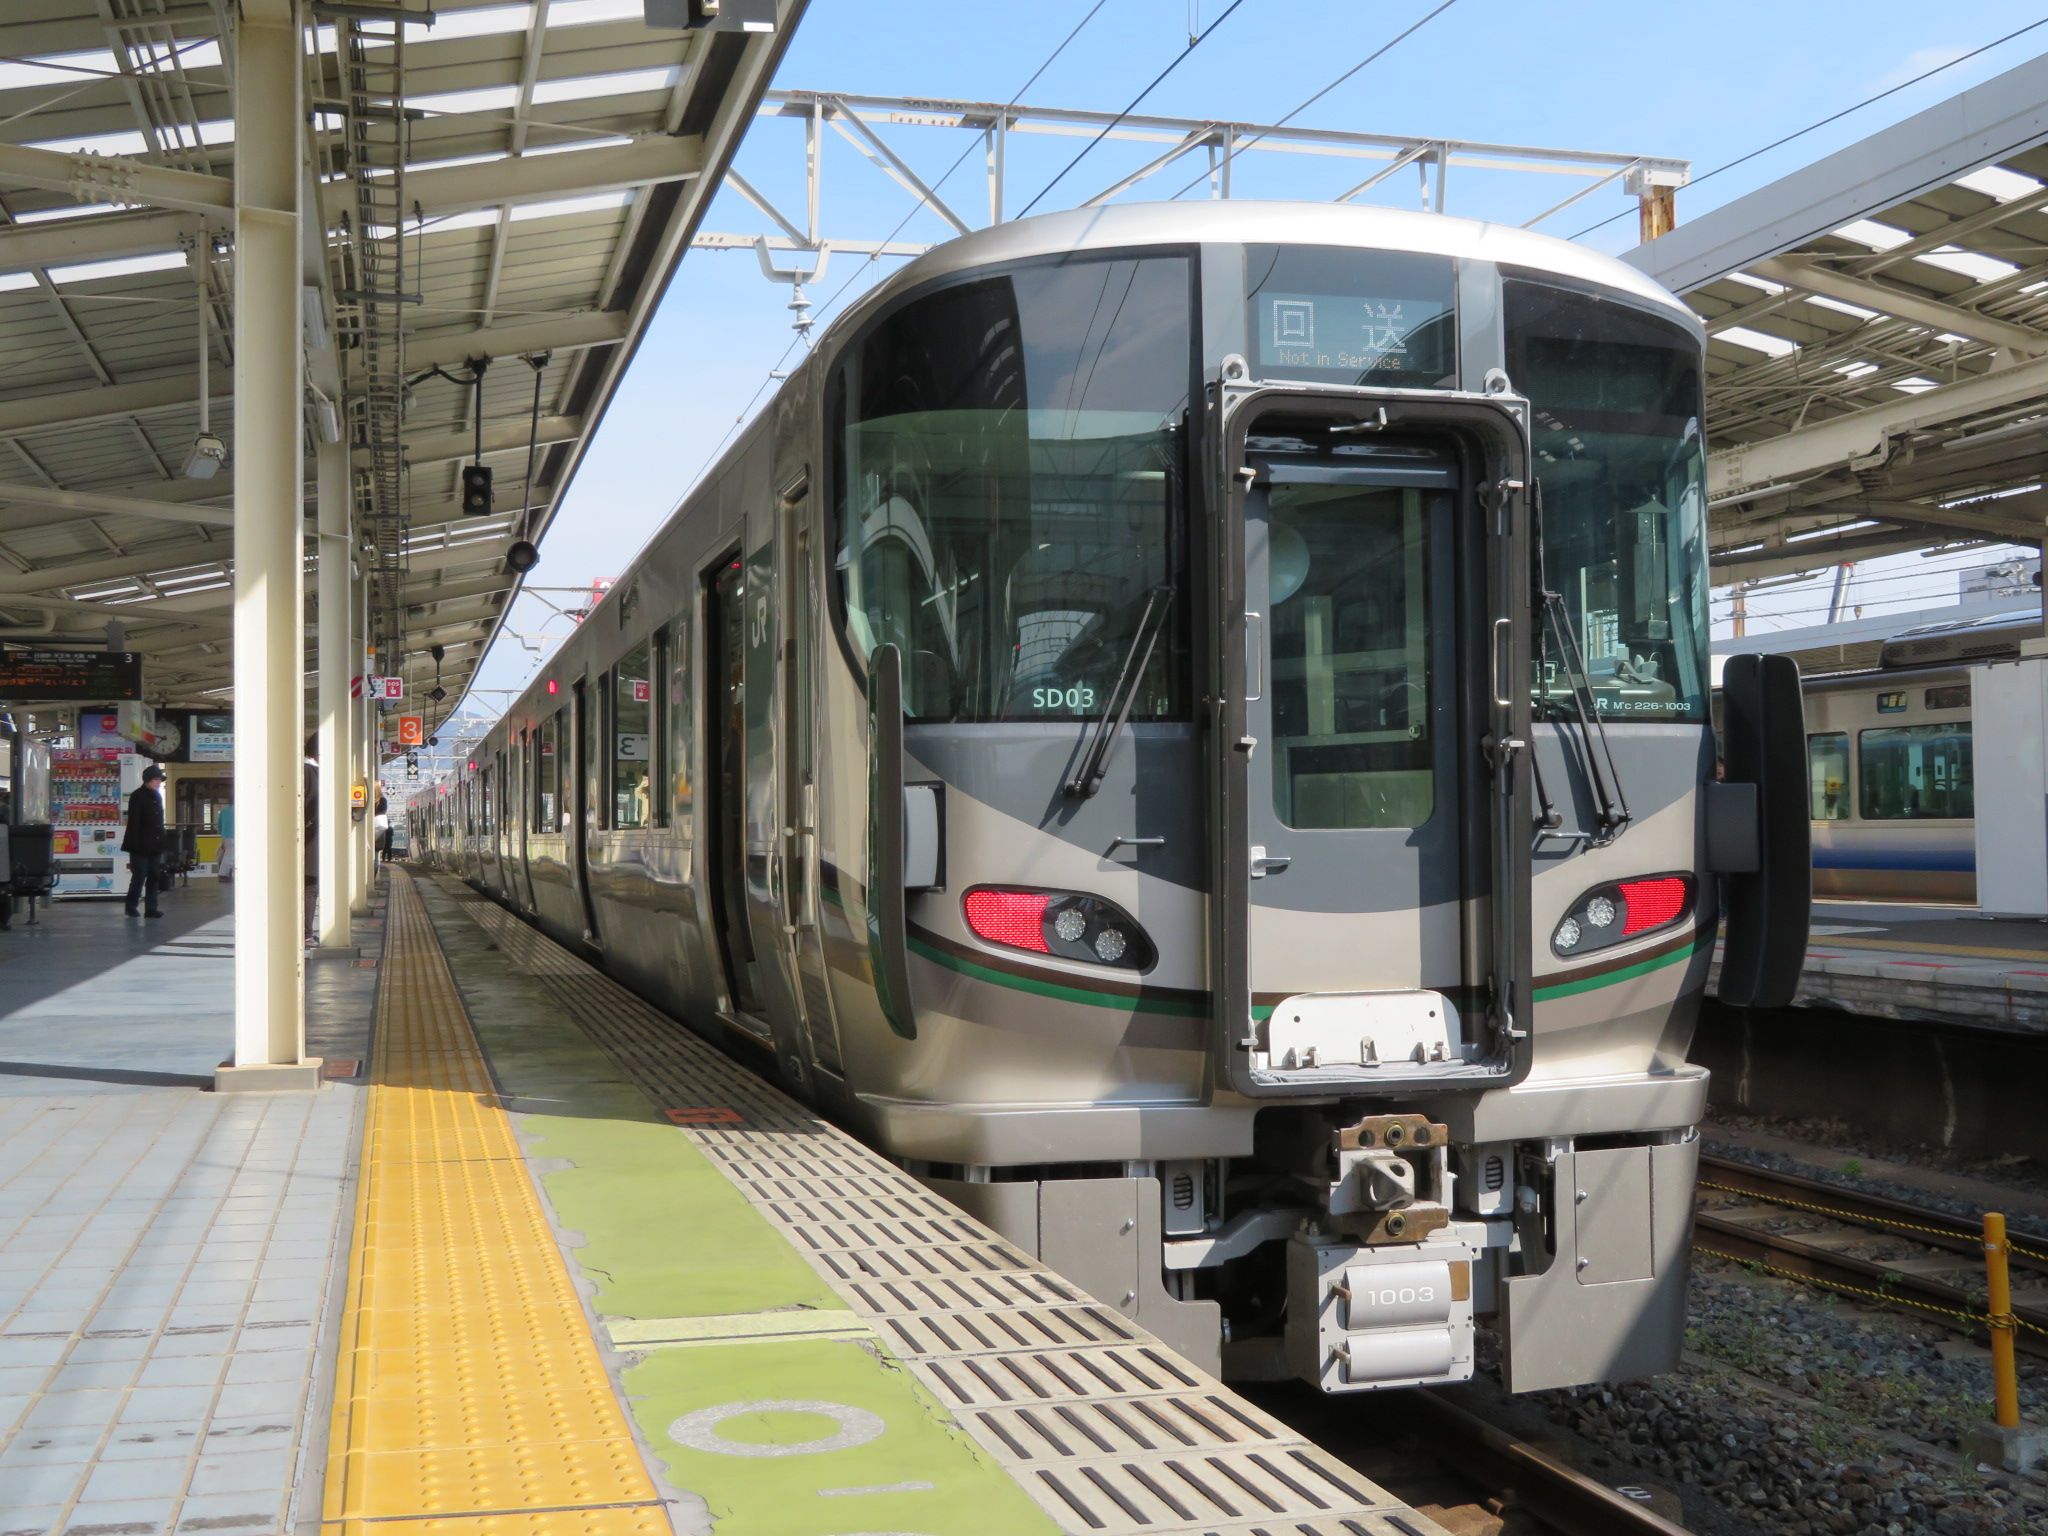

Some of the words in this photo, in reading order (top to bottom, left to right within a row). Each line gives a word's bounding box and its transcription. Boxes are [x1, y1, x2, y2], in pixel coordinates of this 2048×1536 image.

[1273, 300, 1314, 348] 回
[1362, 303, 1407, 353] 送
[1279, 350, 1308, 364] Not
[1338, 352, 1400, 369] Service
[125, 653, 133, 663] 3
[1033, 688, 1094, 708] SD03
[1634, 701, 1691, 711] 226-1003
[403, 721, 418, 740] 3
[1368, 1286, 1434, 1306] 1003
